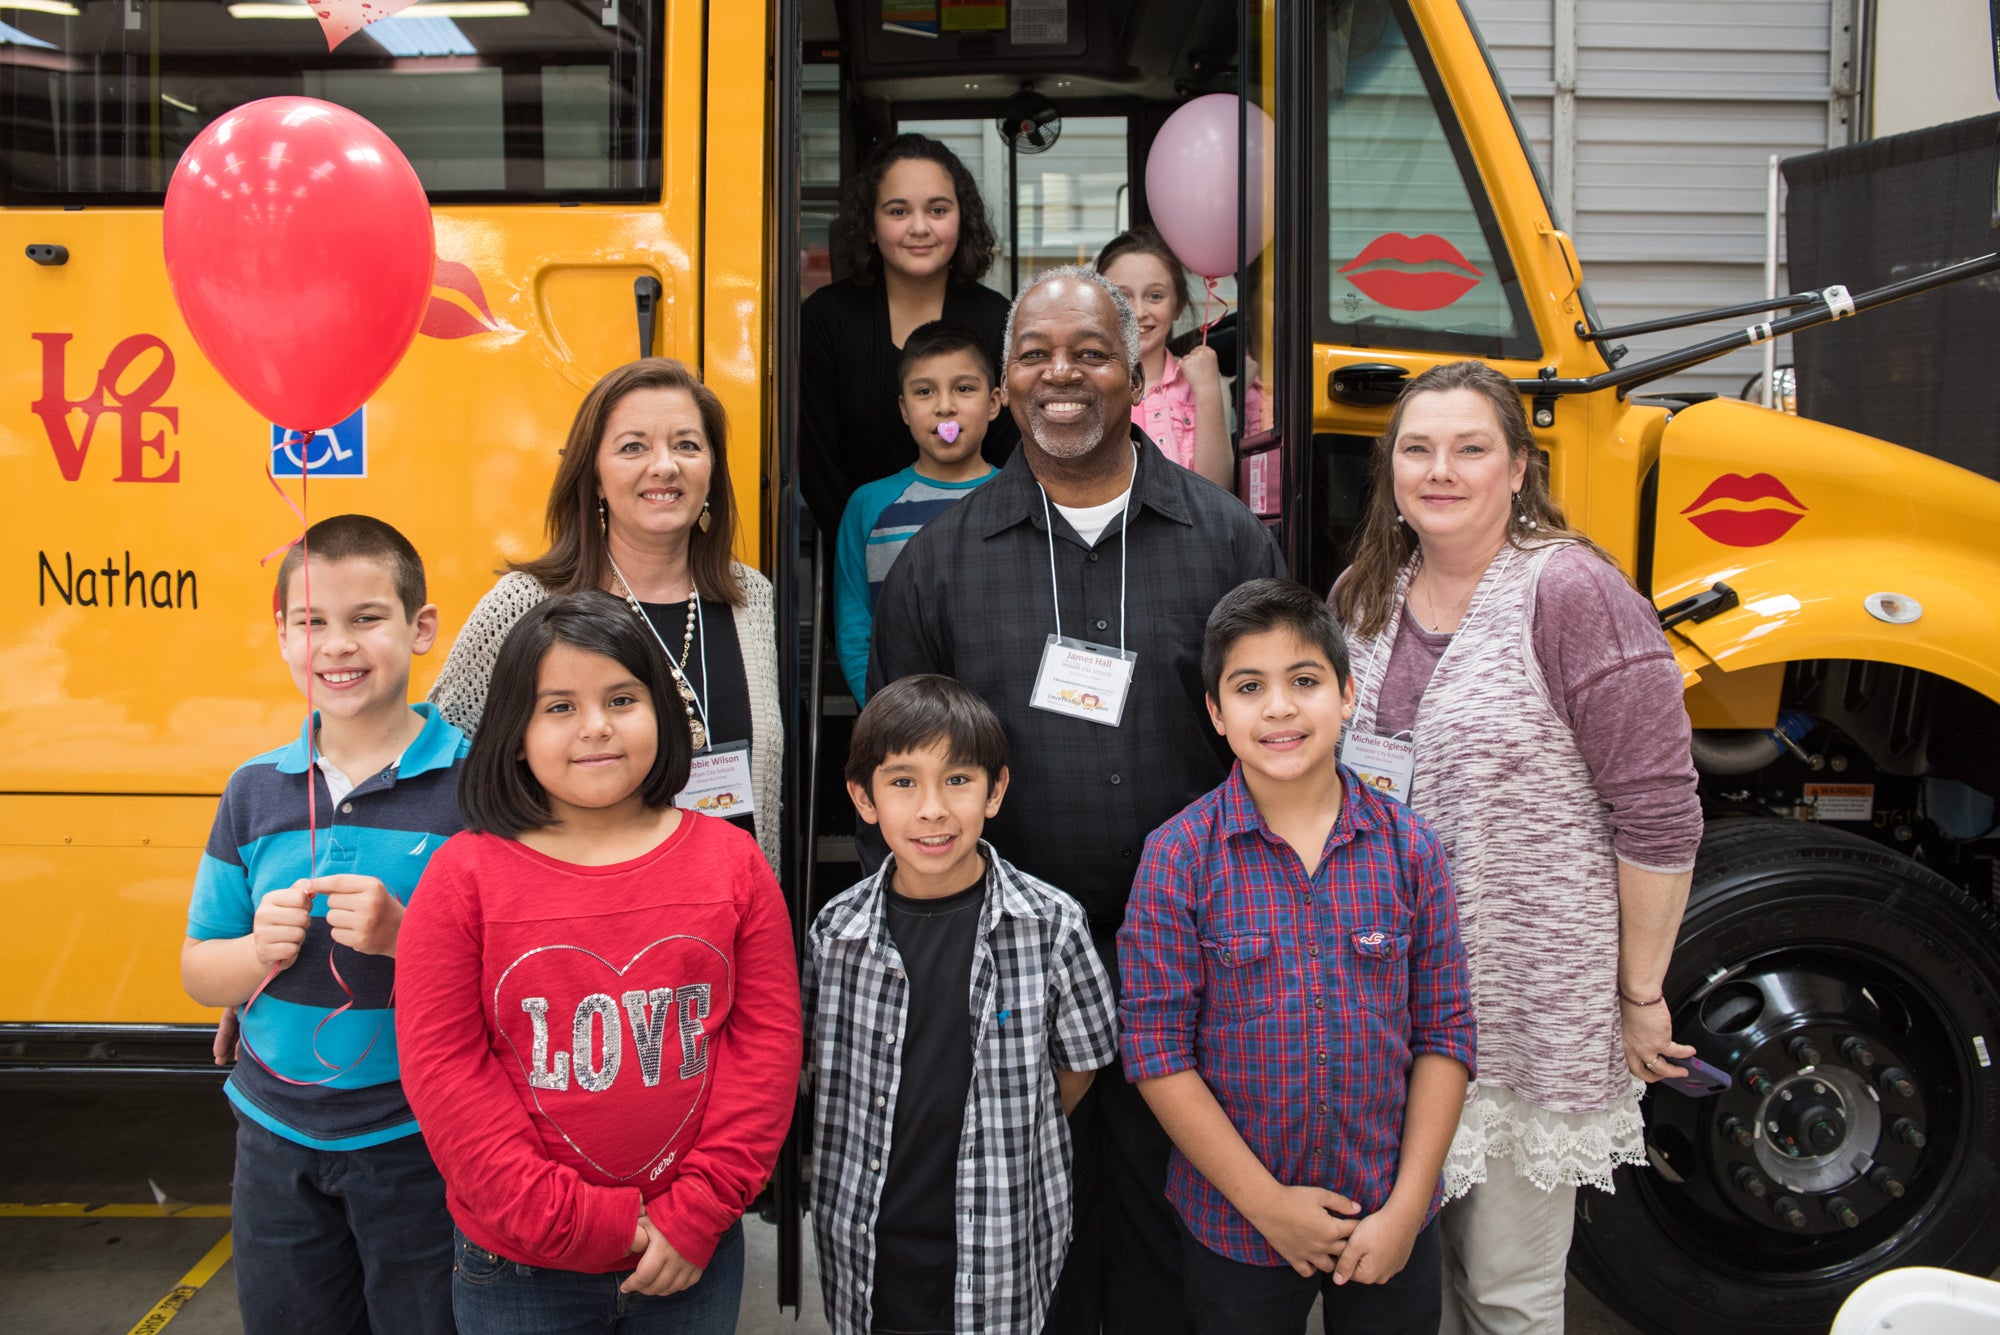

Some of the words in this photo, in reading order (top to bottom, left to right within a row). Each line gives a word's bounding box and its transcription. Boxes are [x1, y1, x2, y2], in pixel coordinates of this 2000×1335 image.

[38, 550, 198, 610] Nathan
[1066, 651, 1093, 664] James
[1095, 657, 1113, 669] Hall
[1351, 734, 1381, 746] Michele
[1383, 740, 1413, 754] Oglesby
[690, 759, 710, 769] bbie
[711, 755, 740, 766] Wilson
[716, 766, 735, 774] Schools
[1821, 786, 1866, 795] WARNING
[521, 983, 712, 1092] LOVE
[649, 1149, 678, 1181] aero
